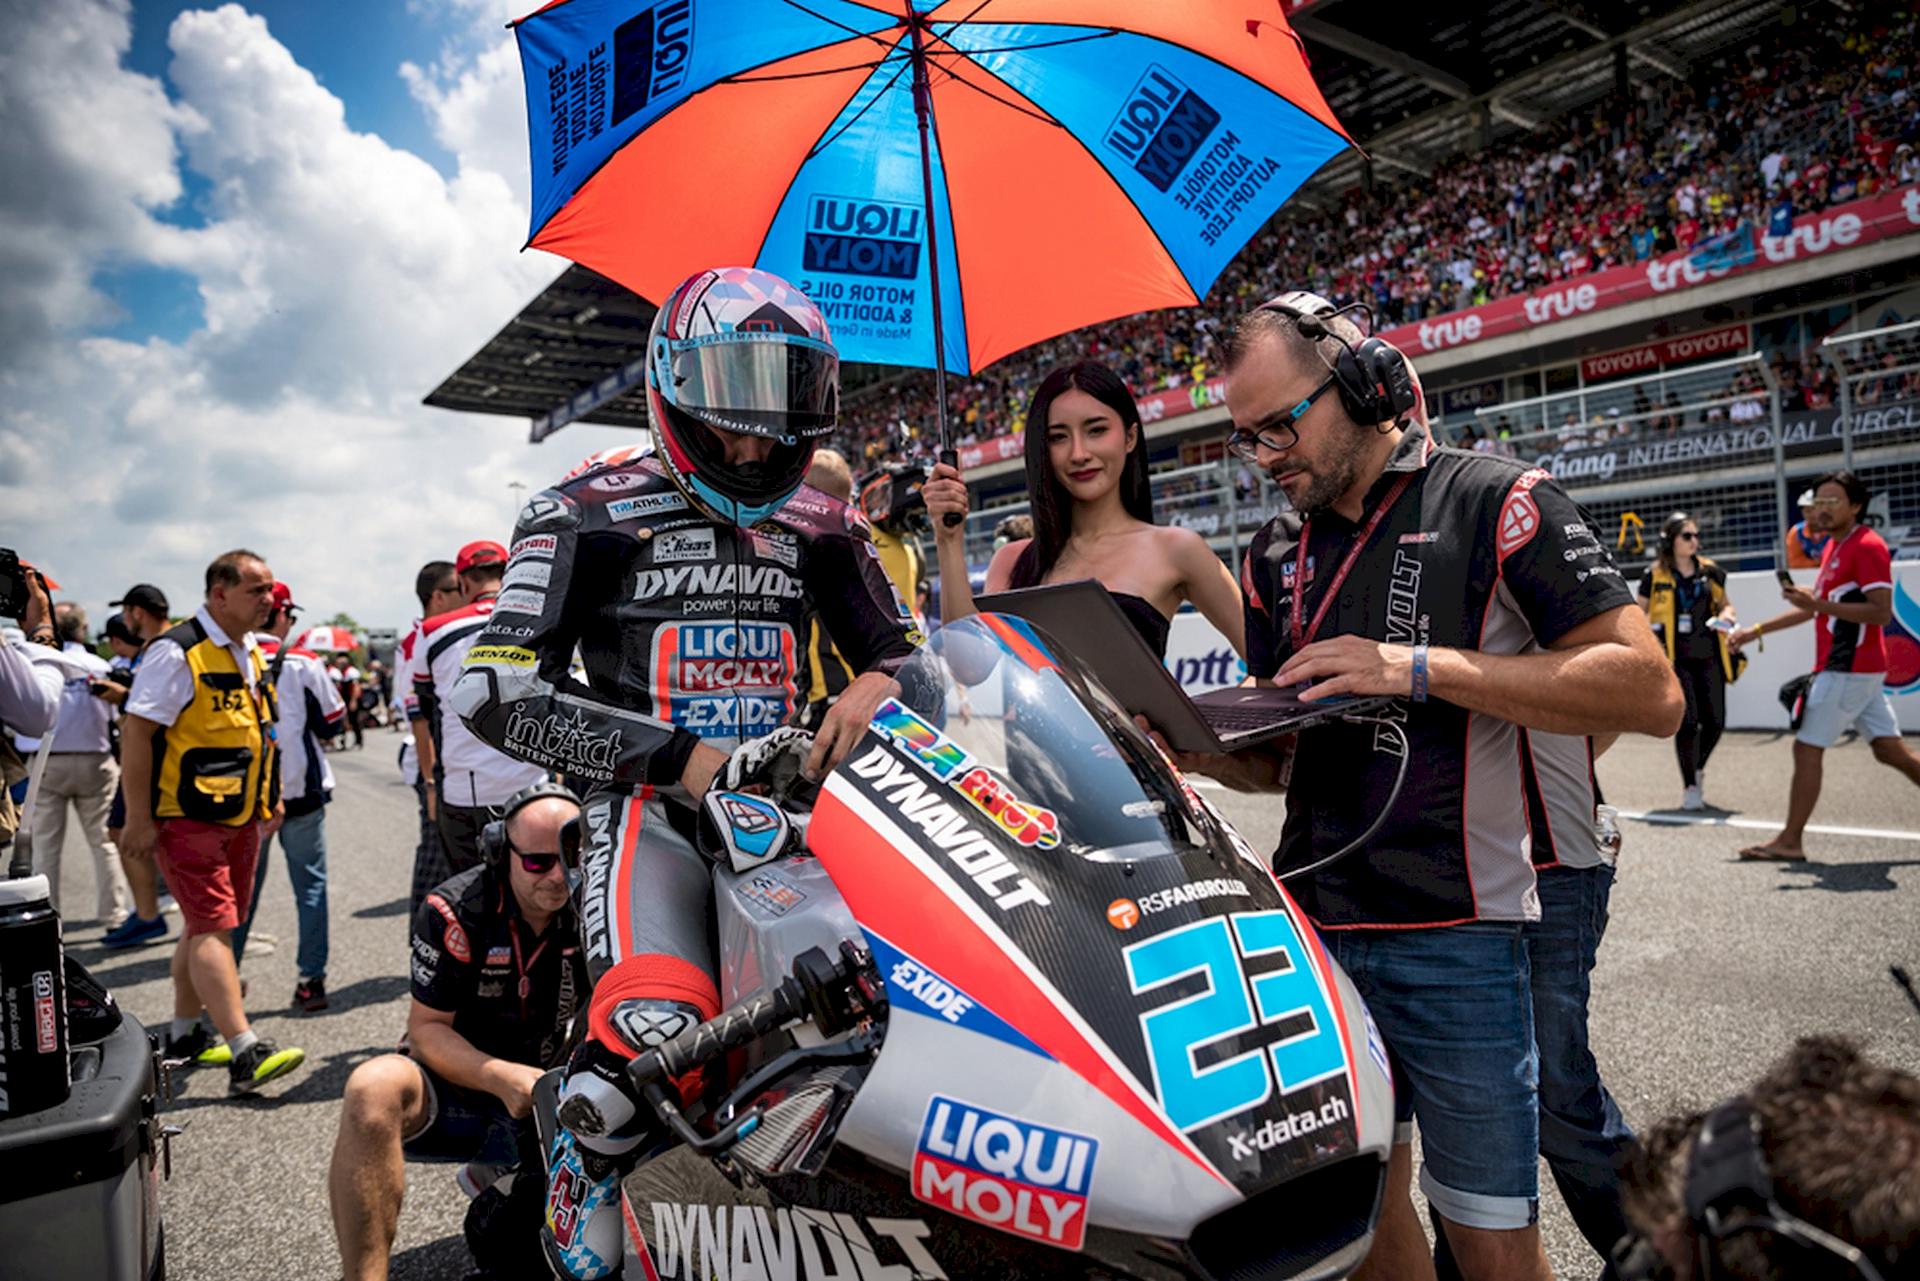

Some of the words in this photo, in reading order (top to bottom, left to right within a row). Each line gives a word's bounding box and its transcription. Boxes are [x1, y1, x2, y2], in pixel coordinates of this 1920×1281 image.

[1761, 213, 1862, 262] true
[1647, 256, 1731, 292] tru
[1523, 283, 1598, 325] true
[1418, 314, 1483, 350] true
[1587, 347, 1658, 376] TOYOTA
[1666, 329, 1746, 358] TOYOTA
[1535, 451, 1618, 480] Chang
[683, 597, 727, 616] power
[763, 597, 781, 613] life
[684, 627, 778, 658] LIQUI
[684, 661, 781, 689] MOLY
[1175, 647, 1234, 686] ptt
[679, 697, 782, 727] EXIDE
[504, 738, 557, 767] BATTERY
[567, 763, 615, 783] POWER
[849, 744, 1051, 911] DYNAVOLT
[890, 960, 974, 1023] EXIDE
[1122, 909, 1348, 1135] 23
[926, 1102, 1091, 1191] LIQUI
[920, 1159, 1081, 1241] MOLY
